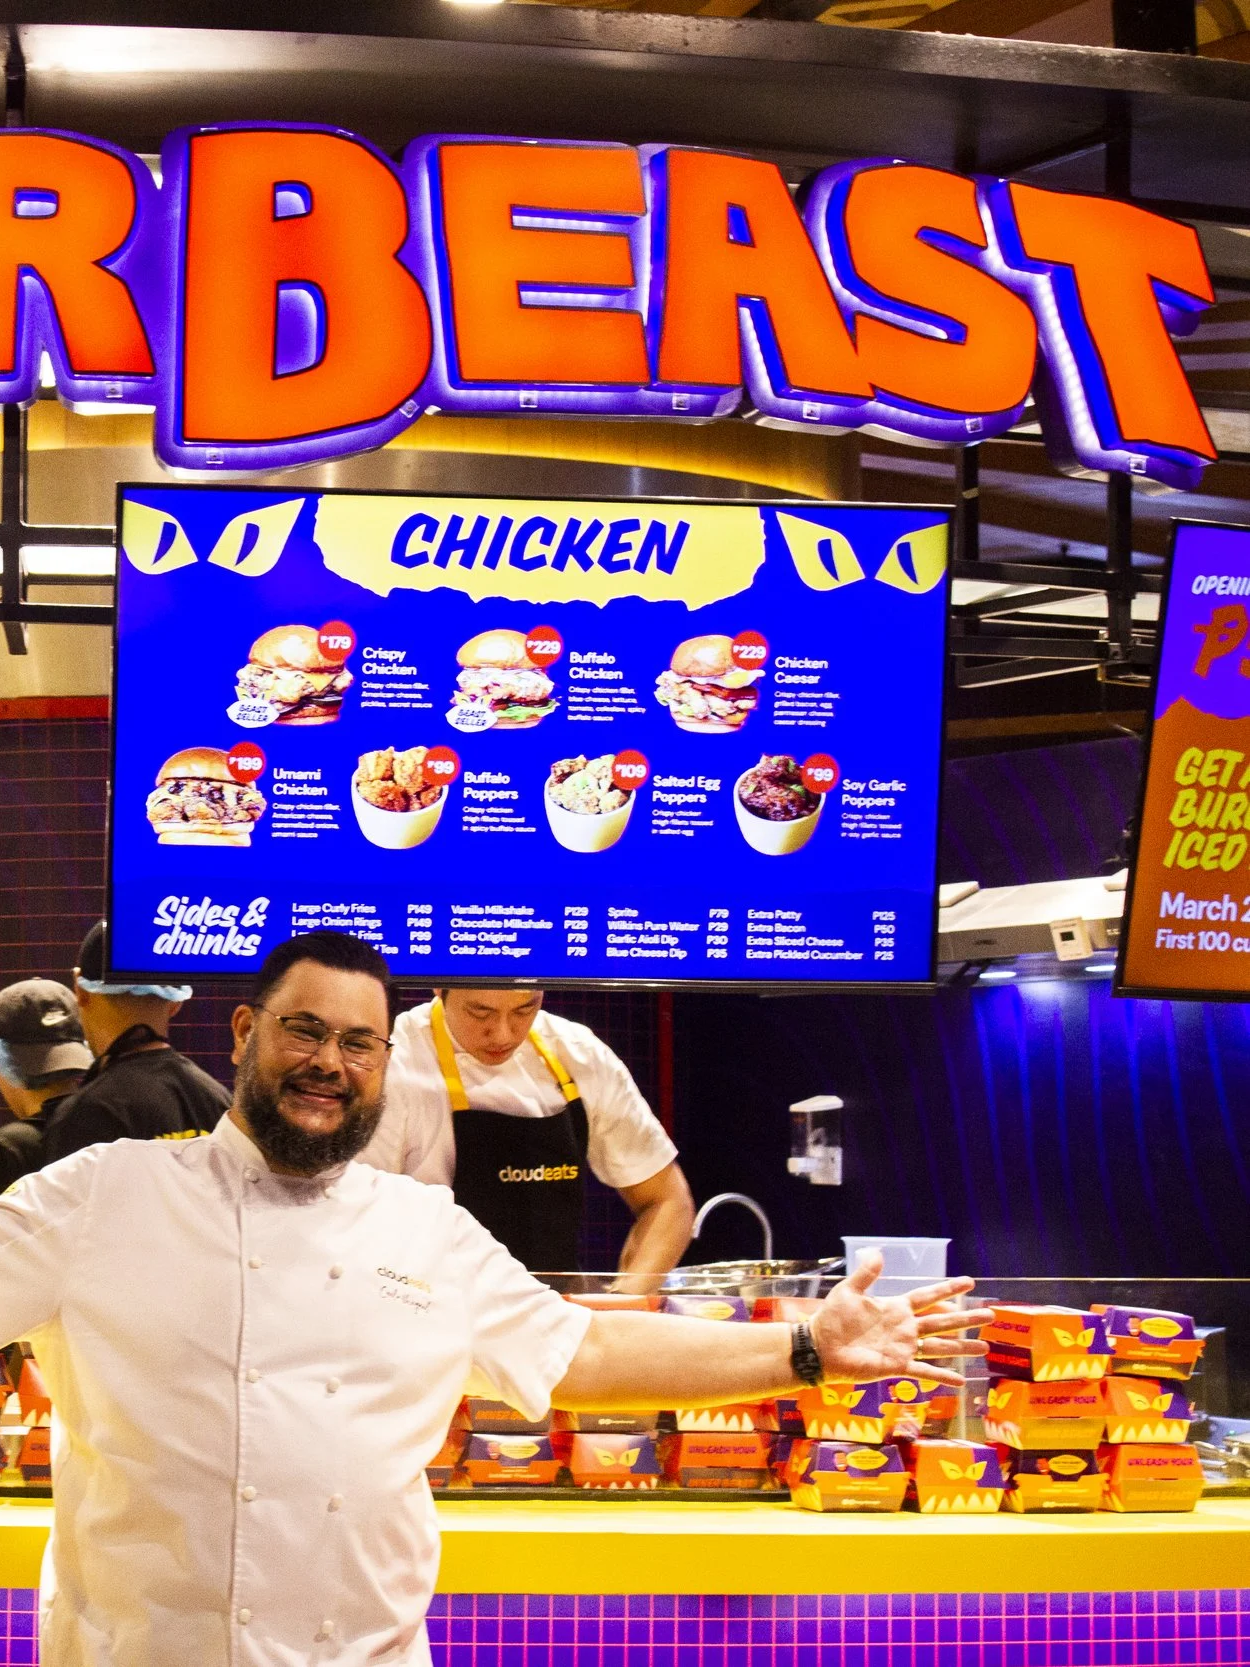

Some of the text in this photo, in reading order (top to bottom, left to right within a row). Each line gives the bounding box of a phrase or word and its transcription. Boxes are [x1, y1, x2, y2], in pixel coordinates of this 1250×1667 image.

[154, 122, 1218, 484] BEAST
[390, 512, 691, 575] CHICKEN
[362, 647, 406, 662] Crispy
[569, 652, 616, 664] Buffalo
[362, 662, 417, 676] Chicken
[775, 656, 828, 669] Chicken
[569, 667, 623, 680] Chicken
[774, 672, 820, 684] Caesar
[273, 768, 322, 780] Umami
[1174, 747, 1245, 788] GET
[464, 771, 511, 784] Buffalo
[653, 775, 721, 791] Salted Egg
[272, 783, 328, 796] Chicken
[842, 779, 906, 793] Soy Garlic
[463, 787, 519, 801] Poppers
[652, 791, 707, 805] Poppers
[841, 794, 896, 808] Poppers
[1168, 788, 1250, 830] BUR
[1162, 830, 1248, 872] ICED
[153, 895, 270, 928] Sides &
[292, 903, 376, 915] Large Curly Fries
[451, 905, 484, 915] Vanilla
[607, 907, 639, 919] Sprite
[1159, 891, 1238, 922] March
[747, 909, 802, 921] Extra Patty
[291, 916, 382, 929] Large Onion Rings
[450, 918, 503, 929] Chocolate
[644, 921, 668, 931] Pure
[747, 923, 806, 933] Extra Bacon
[152, 924, 262, 956] drinks
[357, 930, 383, 940] Fries
[450, 931, 517, 944] Coke Original
[606, 934, 637, 945] Garlic
[661, 935, 679, 947] Dip
[746, 936, 844, 947] Extra Sliced Cheese
[1155, 928, 1230, 952] First 100
[381, 944, 398, 954] Tea
[449, 945, 477, 955] Coke
[477, 945, 501, 956] Zero
[630, 948, 668, 959] Cheese
[669, 948, 687, 960] Dip
[746, 949, 863, 960] Extra Pickled Cucumber
[498, 1163, 579, 1182] cloudeats
